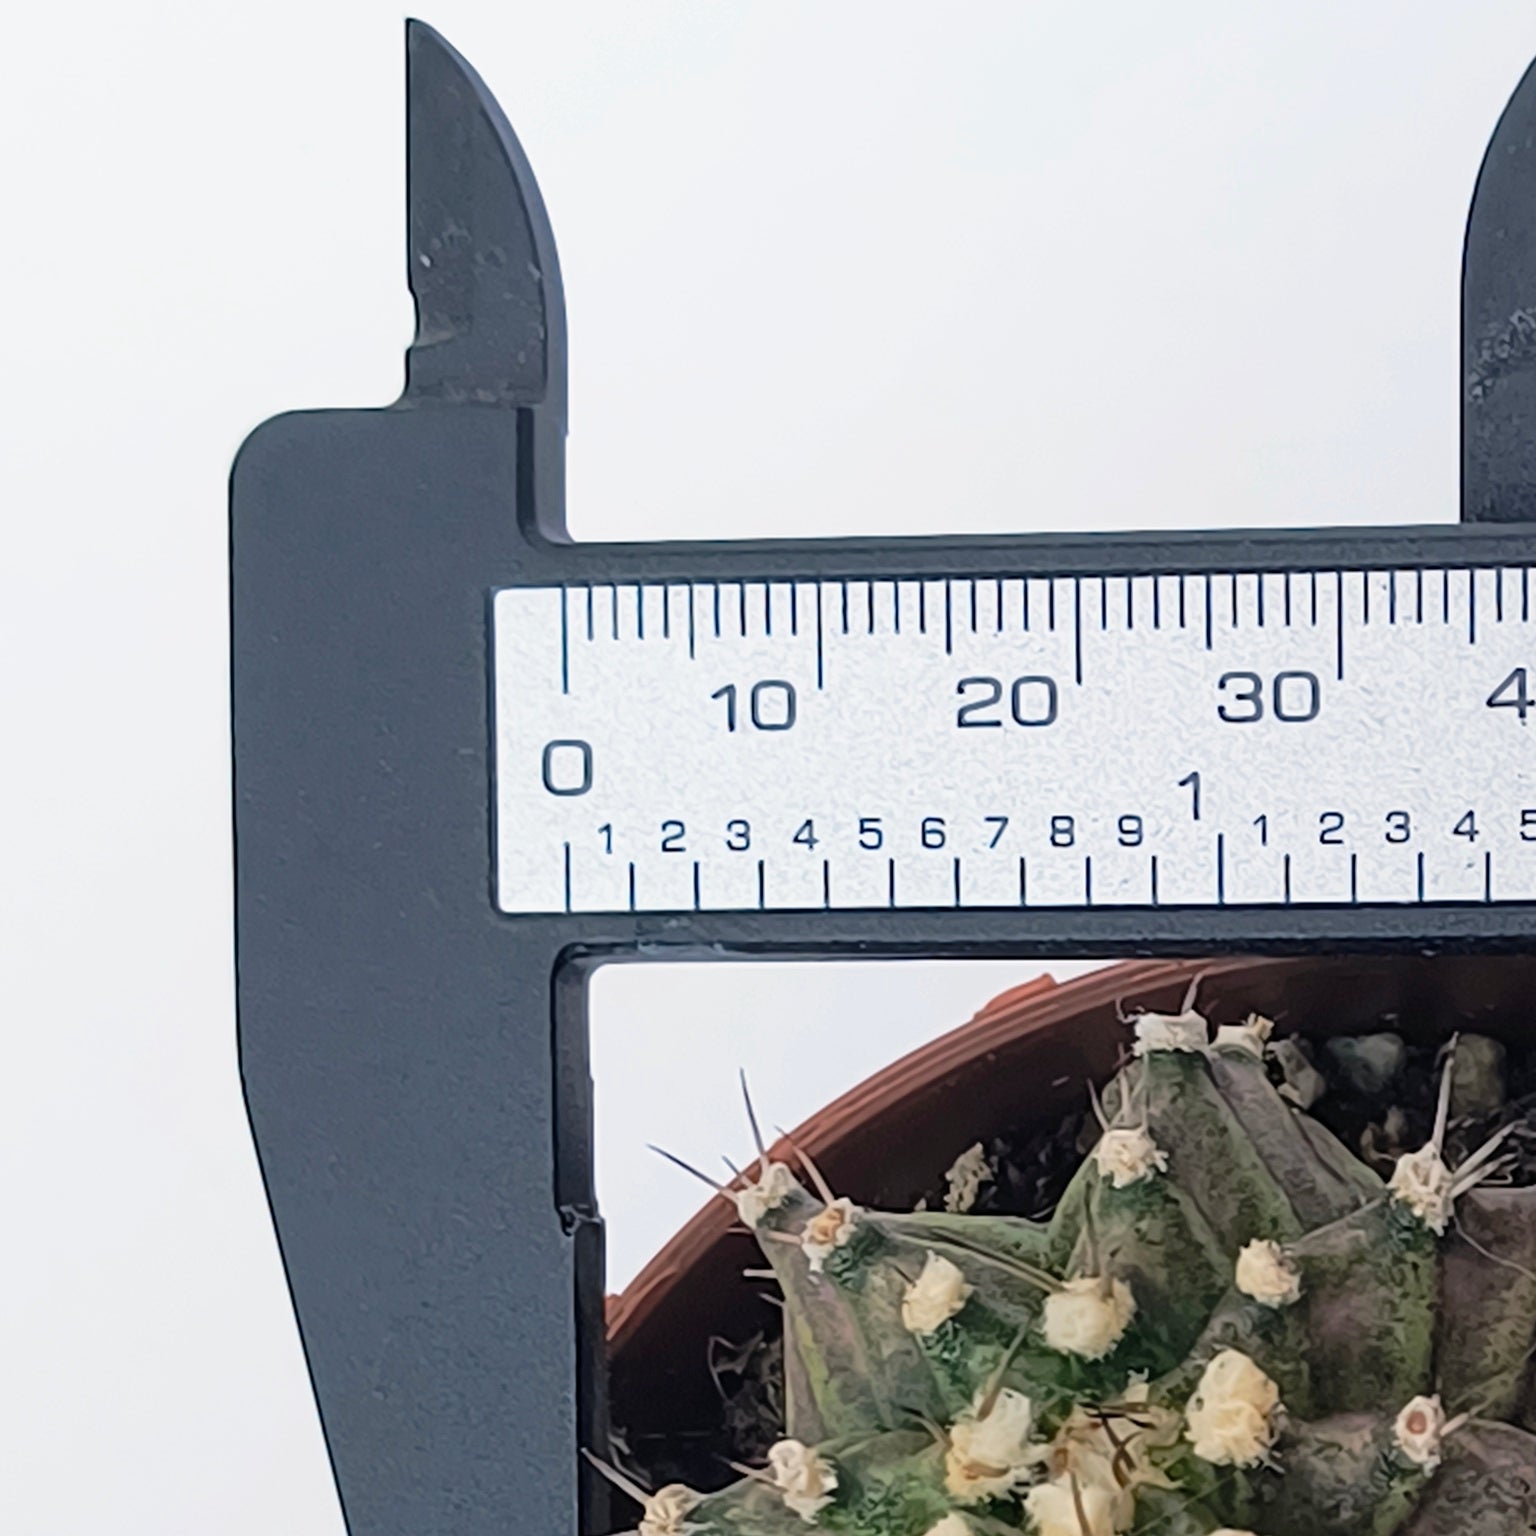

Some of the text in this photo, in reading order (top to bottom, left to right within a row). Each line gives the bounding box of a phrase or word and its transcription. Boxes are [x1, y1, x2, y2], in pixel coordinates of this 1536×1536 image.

[711, 679, 796, 733] 10
[956, 675, 1058, 729] 20
[1217, 670, 1321, 724] 30
[541, 739, 1201, 821] 0 1
[598, 823, 612, 854] 1
[661, 819, 686, 853] 2
[725, 819, 751, 852] 3
[792, 818, 819, 850] 4
[858, 817, 883, 851] 5
[921, 816, 946, 850] 6
[984, 816, 1009, 849] 7
[1049, 815, 1075, 848] 8
[1117, 814, 1143, 848] 9
[1253, 813, 1267, 847] 1
[1319, 811, 1345, 845] 2
[1385, 810, 1411, 844] 3
[1452, 809, 1480, 843] 4
